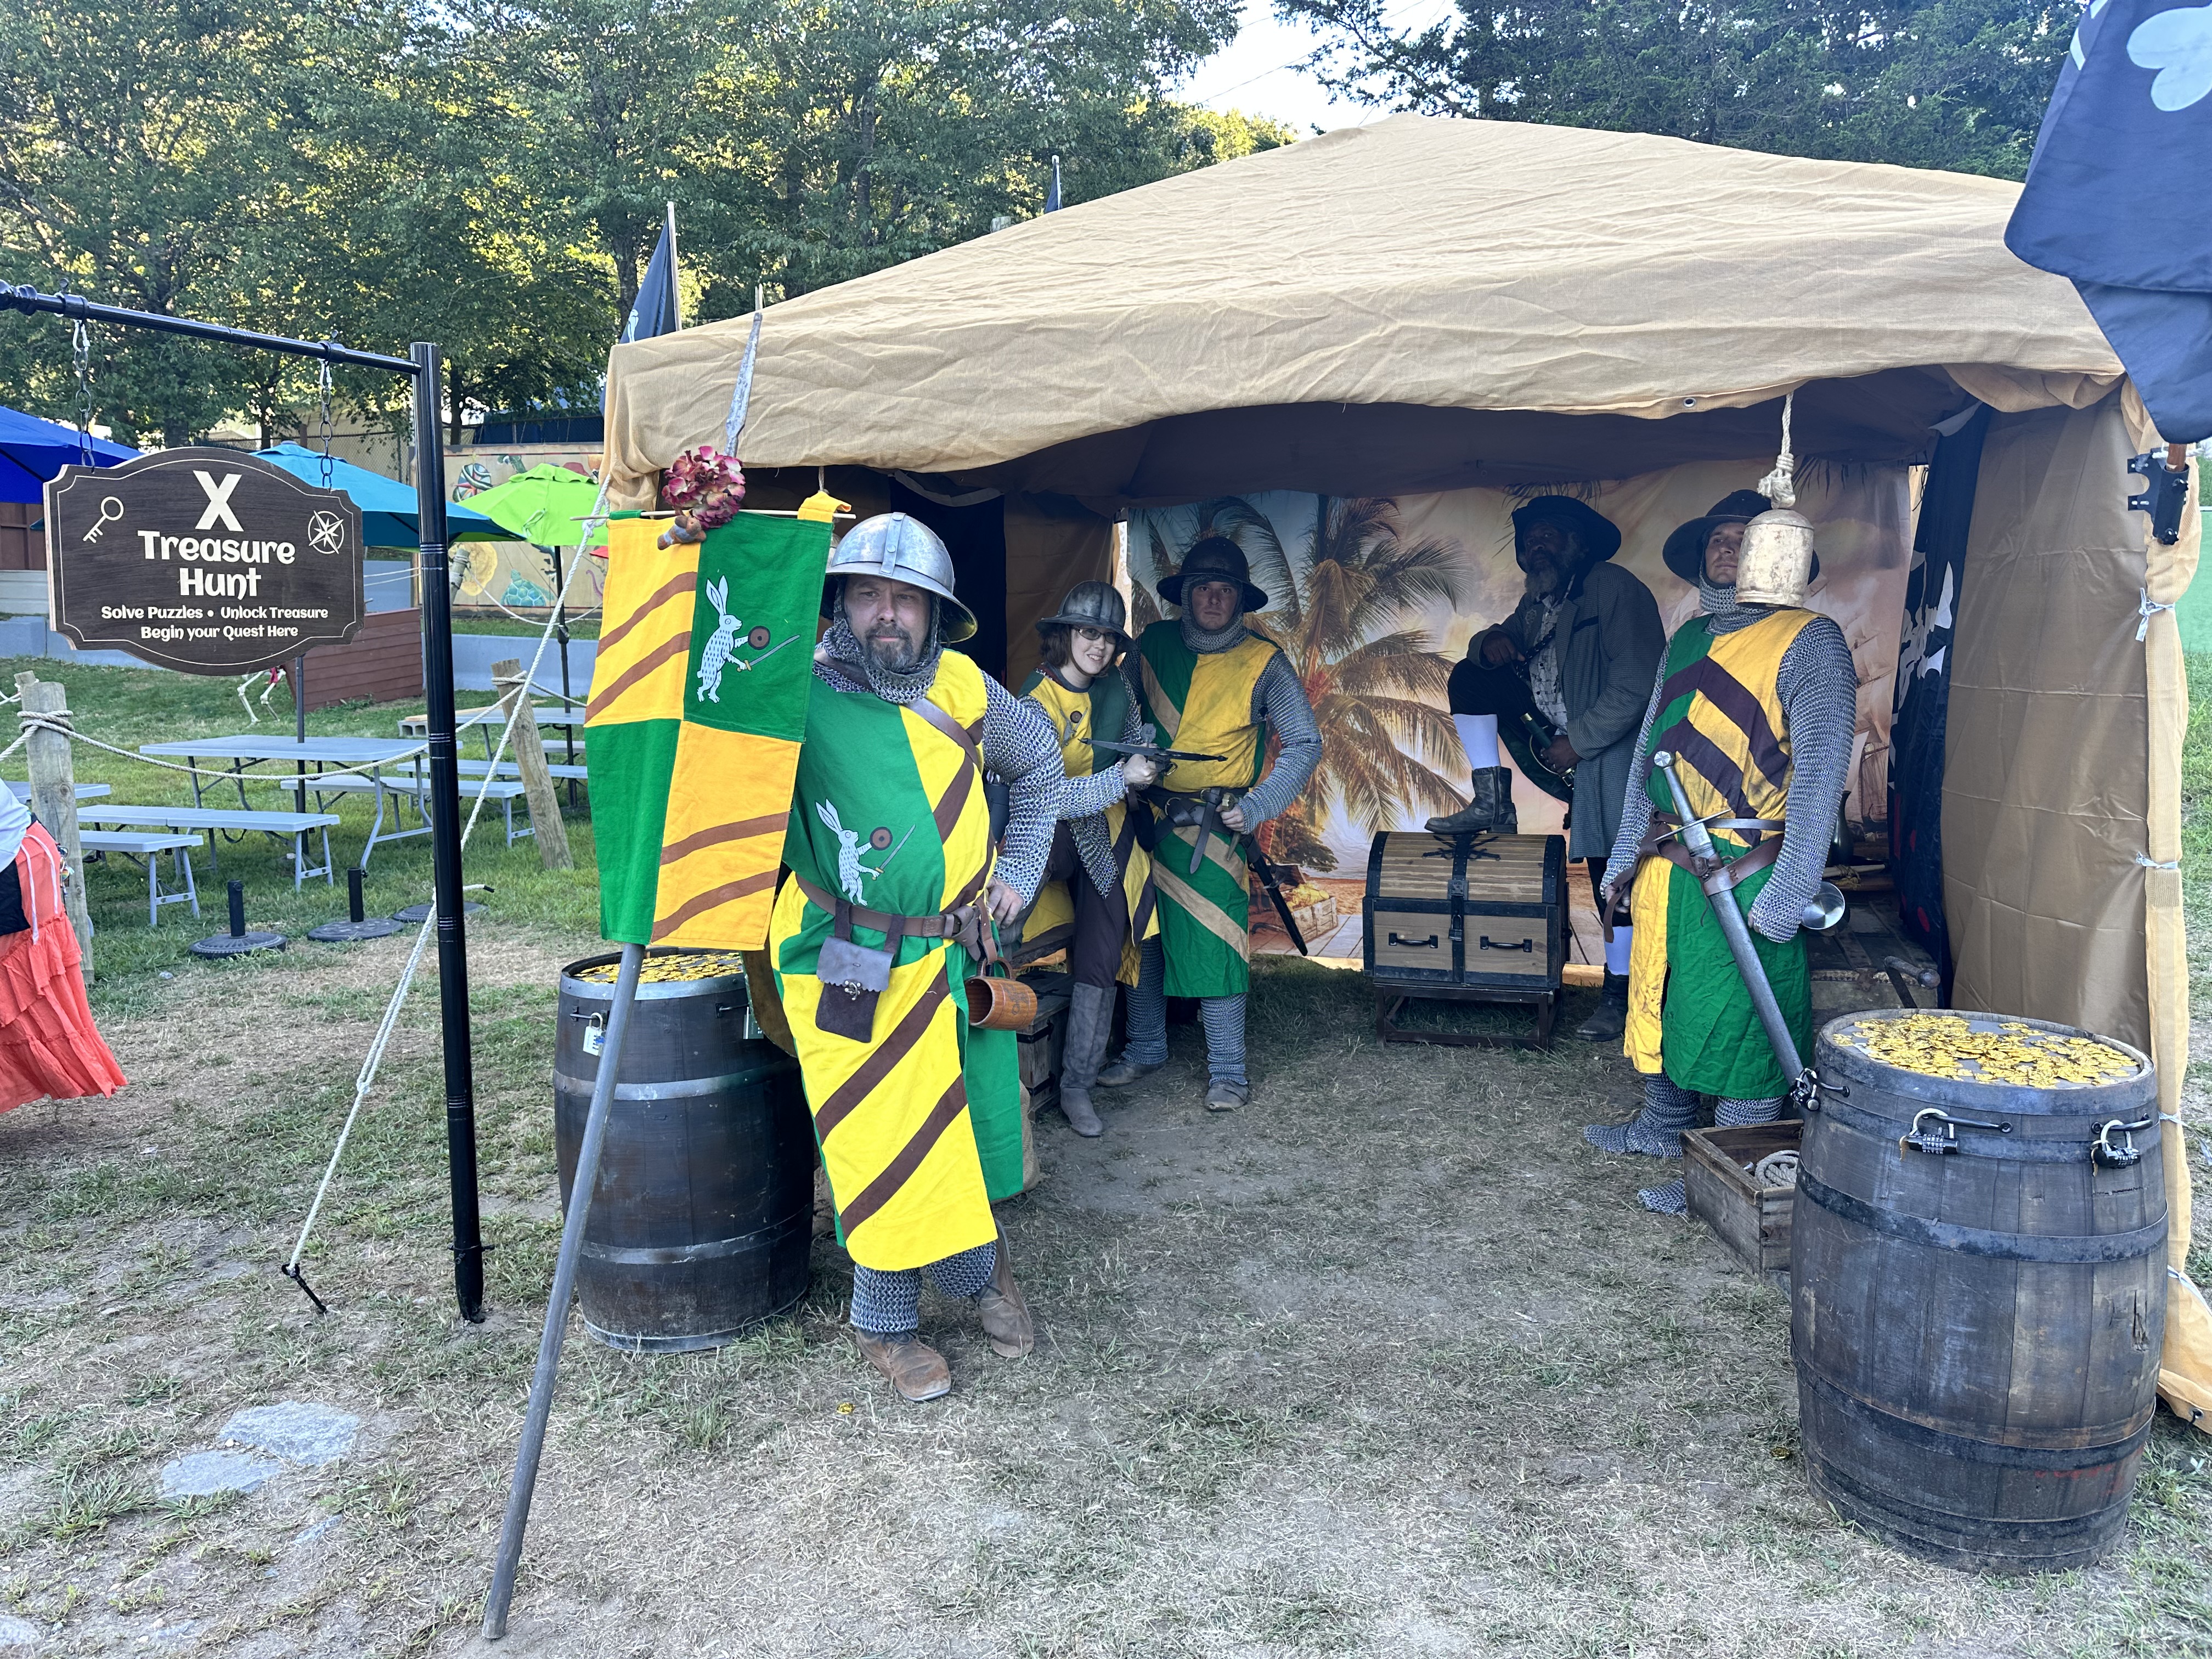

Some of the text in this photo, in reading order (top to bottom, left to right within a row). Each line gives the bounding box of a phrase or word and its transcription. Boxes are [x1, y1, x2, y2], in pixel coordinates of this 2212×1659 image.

[193, 470, 244, 532] X
[138, 531, 295, 564] Treasure
[180, 568, 261, 600] Hunt
[101, 605, 328, 619] Solve Puzzles Unlock Treasure
[141, 625, 298, 641] Begin your Quest Here
